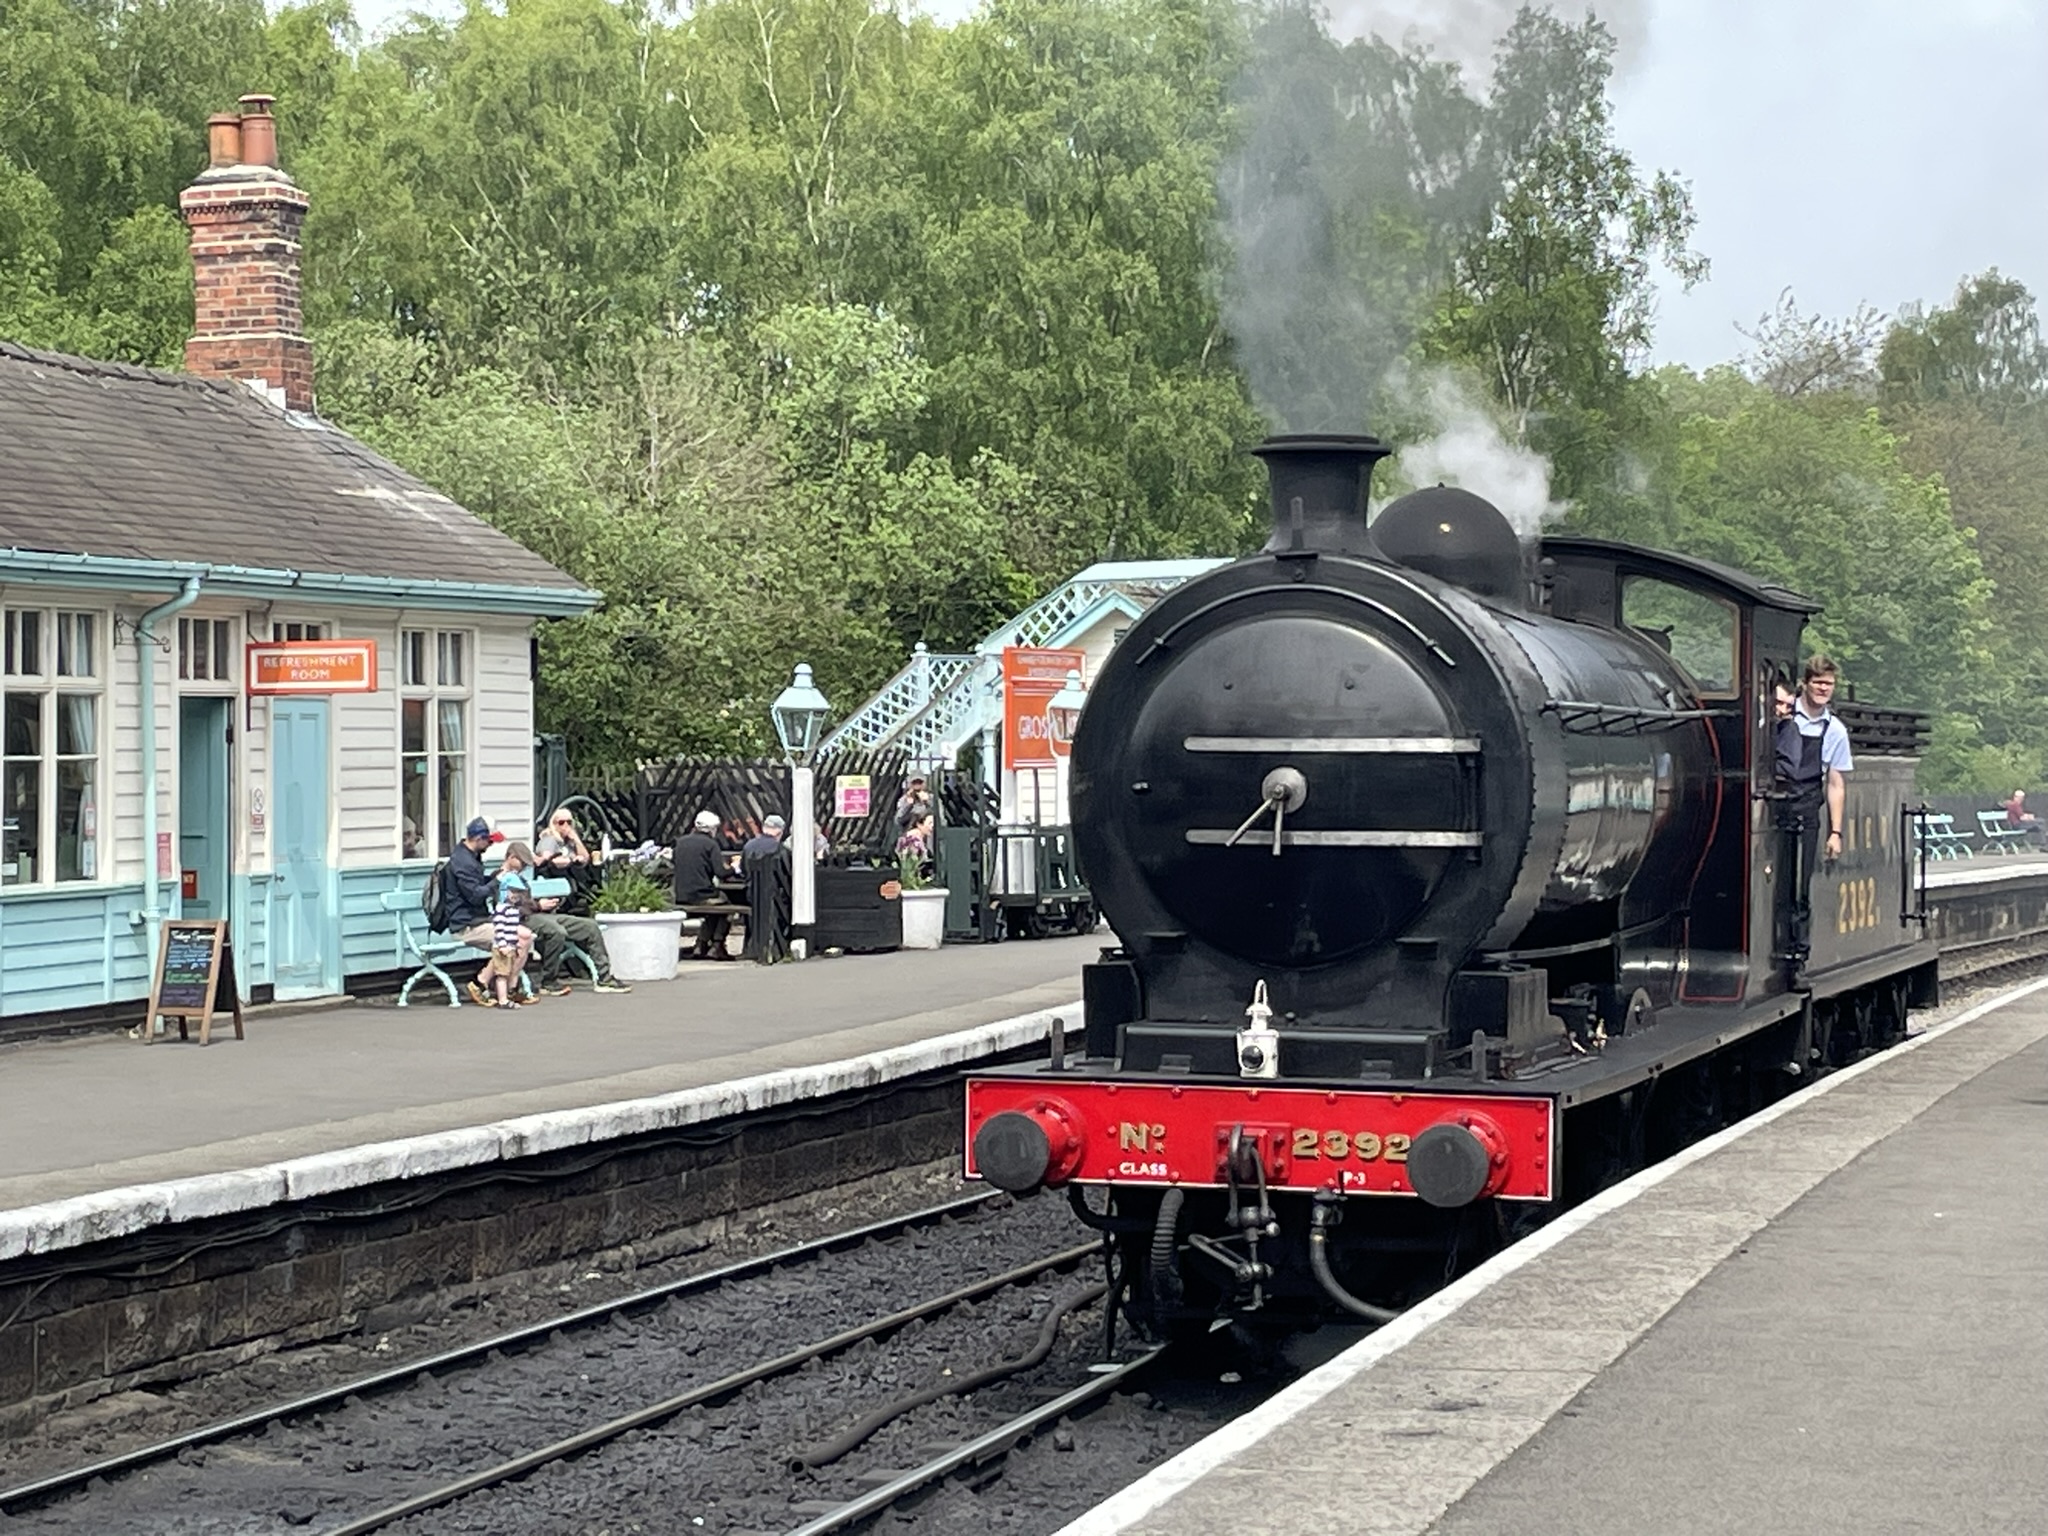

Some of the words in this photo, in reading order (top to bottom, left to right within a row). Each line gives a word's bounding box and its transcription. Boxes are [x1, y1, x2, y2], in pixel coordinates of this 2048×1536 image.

[263, 656, 357, 668] REFRESHMENT
[290, 669, 331, 680] ROOM
[1292, 1128, 1411, 1162] 2392
[1119, 1161, 1168, 1177] CLASS
